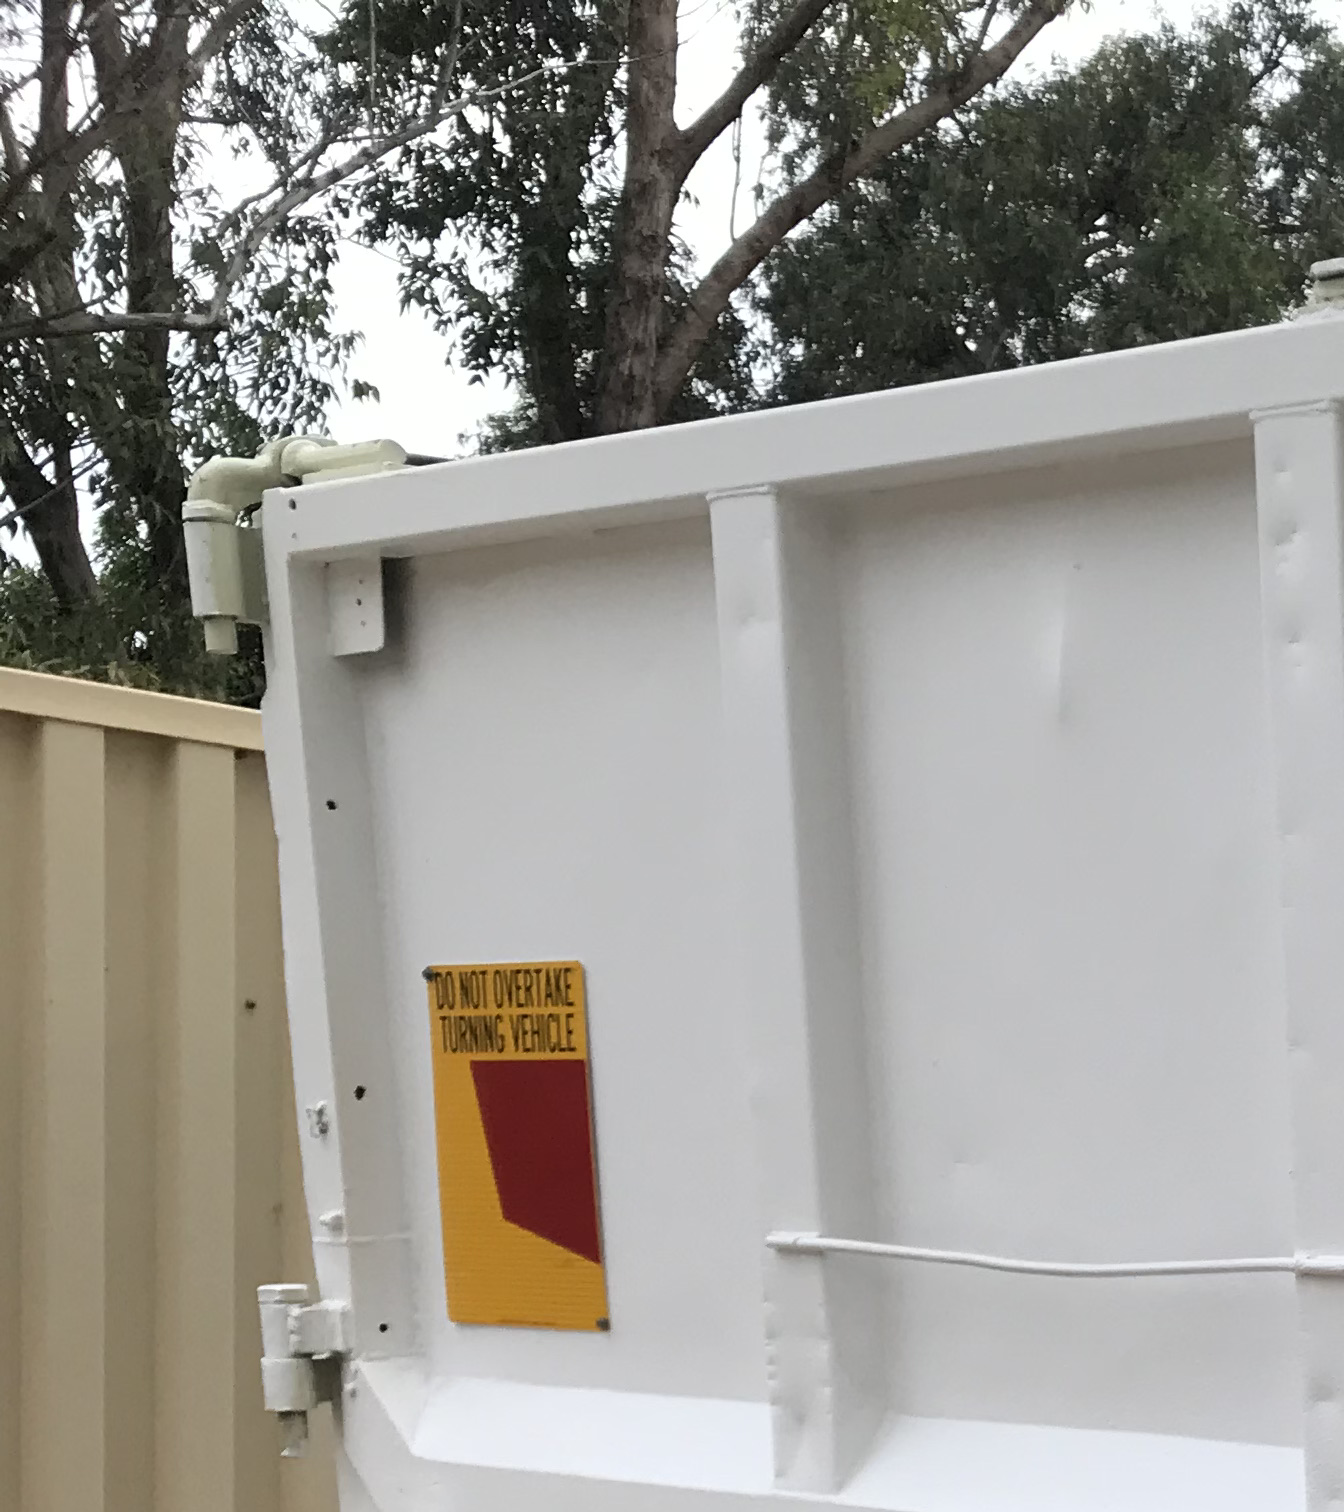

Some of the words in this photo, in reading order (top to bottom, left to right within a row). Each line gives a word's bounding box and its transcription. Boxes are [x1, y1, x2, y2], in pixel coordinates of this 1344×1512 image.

[434, 970, 455, 1010] DO
[459, 969, 488, 1010] NOT
[493, 967, 575, 1009] OVERTAKE
[439, 1014, 506, 1053] TURNING
[509, 1013, 577, 1053] VEHICLE
